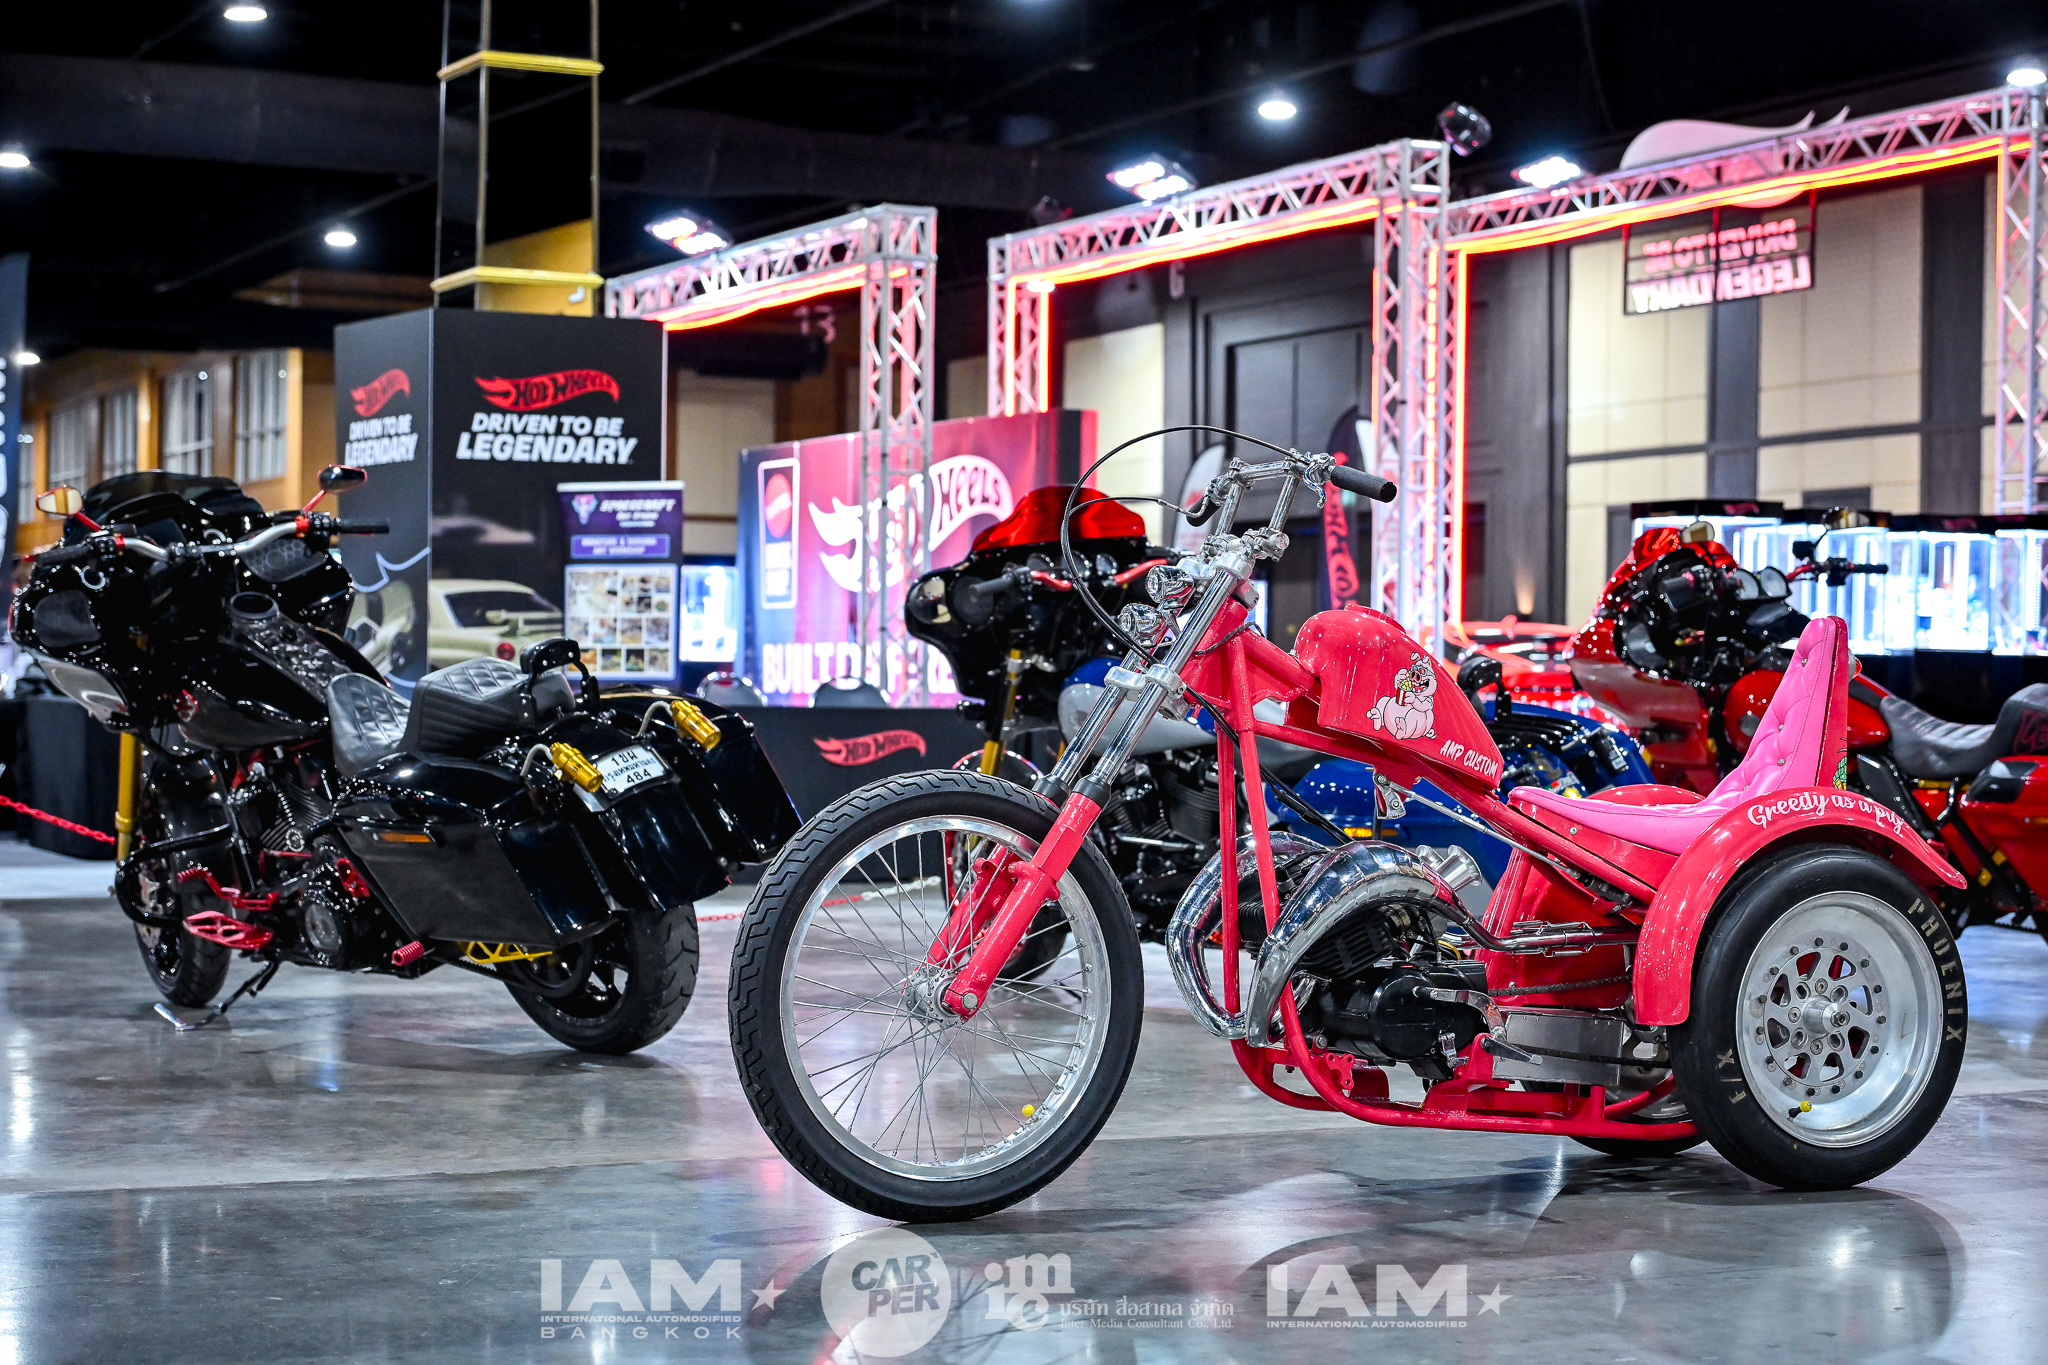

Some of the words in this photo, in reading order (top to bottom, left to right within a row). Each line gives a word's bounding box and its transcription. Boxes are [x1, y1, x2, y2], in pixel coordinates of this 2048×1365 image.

[471, 412, 559, 435] DRIVEN
[560, 415, 592, 436] TO
[593, 417, 624, 437] BE
[456, 431, 638, 465] LEGENDARY
[762, 642, 835, 695] BUILT
[627, 768, 652, 784] 484
[1440, 739, 1465, 761] AMP
[1463, 749, 1499, 779] CUSTOM
[1747, 791, 1830, 829] Greedy
[1831, 794, 1856, 809] as
[1858, 799, 1873, 814] a
[1873, 805, 1905, 838] pig
[1907, 897, 1963, 1043] PHOENIX
